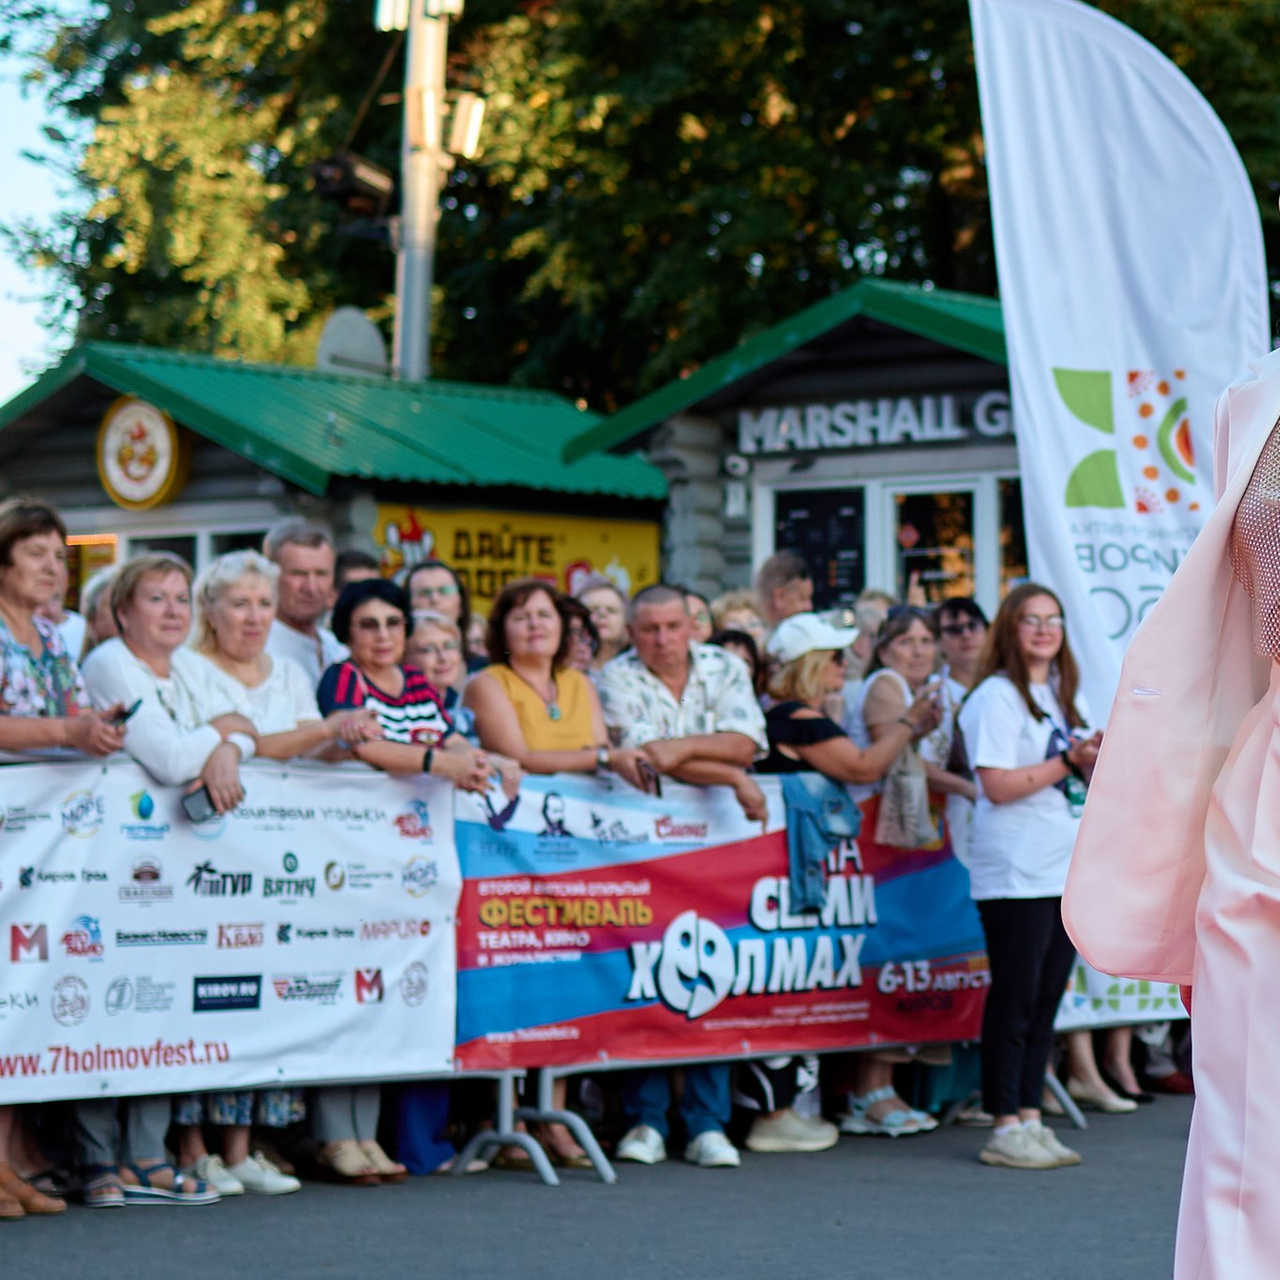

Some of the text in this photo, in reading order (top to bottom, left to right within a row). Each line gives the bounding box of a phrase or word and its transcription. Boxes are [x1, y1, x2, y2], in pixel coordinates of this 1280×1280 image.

[738, 390, 1015, 454] MARSHALL G
[479, 897, 653, 928] ФЕСТИВАЛЬ
[544, 929, 591, 947] КИНО
[197, 982, 258, 998] KIROV.RU
[878, 959, 932, 994] 6-13
